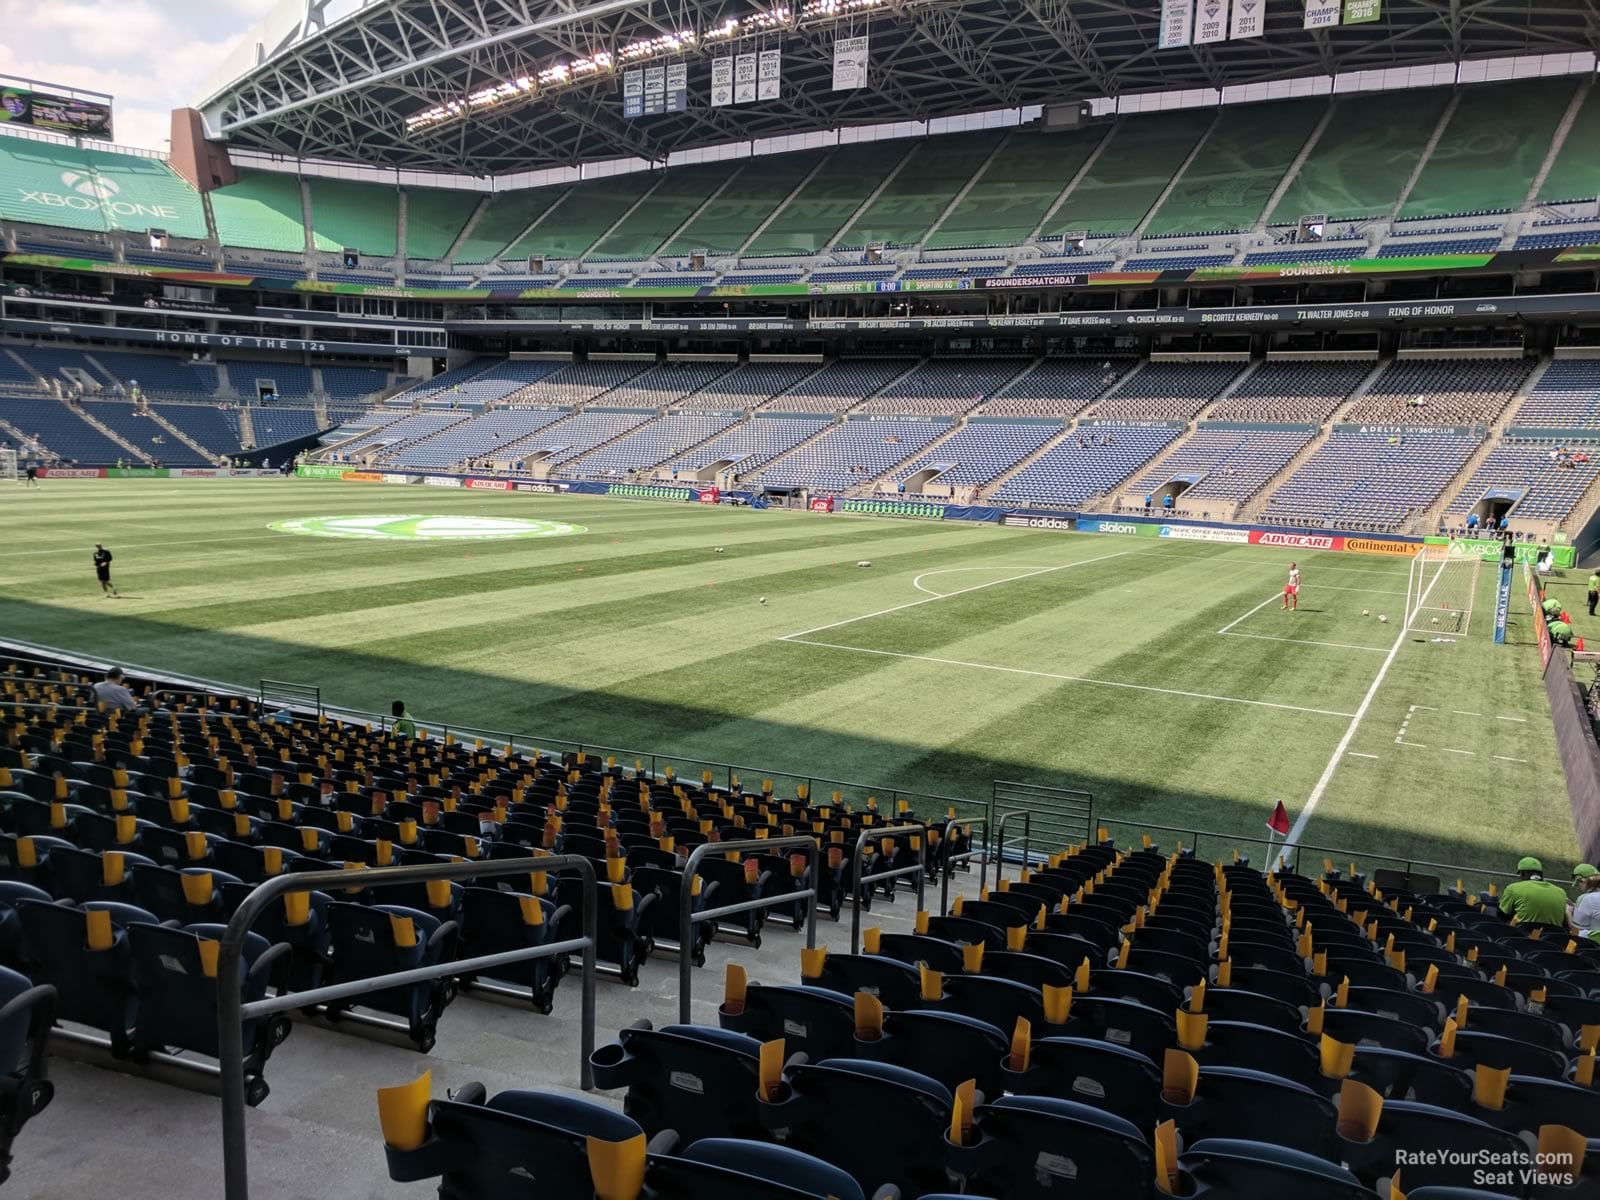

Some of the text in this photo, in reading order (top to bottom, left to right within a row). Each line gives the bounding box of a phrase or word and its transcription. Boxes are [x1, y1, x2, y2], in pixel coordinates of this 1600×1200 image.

[1306, 7, 1339, 17] CHAMPS
[1352, 8, 1372, 18] 2016
[1240, 17, 1256, 26] 2011
[1312, 16, 1330, 24] 2014
[1202, 22, 1220, 30] 2009
[1202, 30, 1218, 38] 2010
[738, 64, 752, 74] 2013
[762, 62, 776, 70] 2014
[715, 68, 730, 76] 2005
[17, 188, 180, 219] XBOX ONE
[1280, 266, 1334, 277] SOUNDERS
[1337, 264, 1352, 274] FC
[880, 282, 896, 290] 0:00
[906, 282, 910, 290] 0
[916, 280, 944, 289] SPORTING
[986, 276, 1076, 287] #SOUNDERSMATCHDAY
[364, 288, 402, 296] SOUNDERS
[1297, 311, 1307, 319] 71
[1307, 311, 1332, 319] WALTER
[1333, 310, 1354, 318] JONES
[1388, 306, 1454, 316] RING OF HONOR
[1236, 312, 1264, 321] KENNEDY
[156, 332, 326, 350] HOME OF THE 12s
[474, 482, 506, 490] ADVOCARE
[531, 484, 554, 492] adidas
[1030, 517, 1069, 530] adidas
[1099, 522, 1136, 534] slalom
[1260, 534, 1332, 548] ADVOCARE
[1347, 538, 1407, 553] Continental
[1468, 543, 1503, 556] XBOX
[276, 1024, 283, 1038] N
[32, 1090, 40, 1104] P
